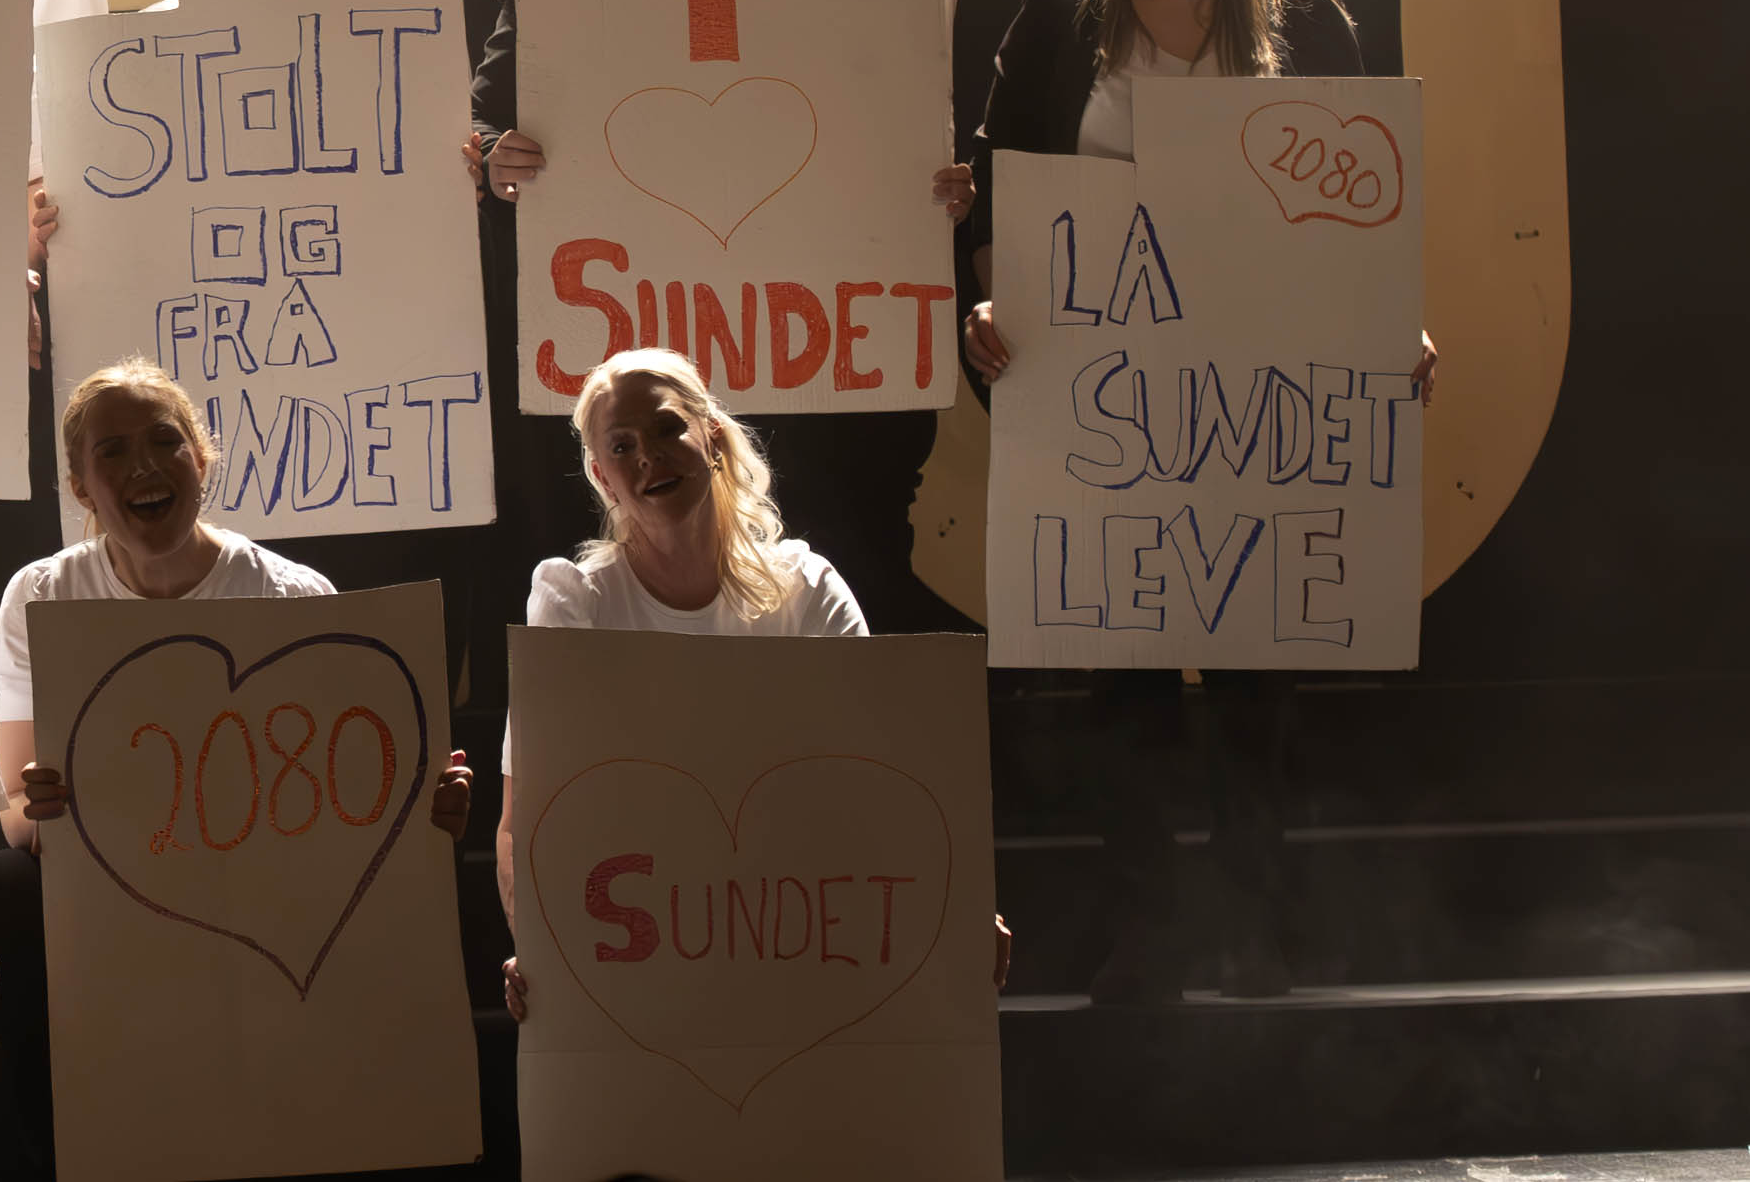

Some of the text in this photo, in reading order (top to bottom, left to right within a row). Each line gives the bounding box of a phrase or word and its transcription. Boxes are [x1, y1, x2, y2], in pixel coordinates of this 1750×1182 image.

[82, 7, 443, 199] STOLT
[1269, 125, 1382, 210] 2080
[190, 204, 342, 286] OG
[1049, 202, 1184, 327] LA
[155, 277, 338, 381] FRA
[536, 237, 955, 398] SUNDET
[1065, 350, 1420, 491] SUNDET
[1033, 505, 1353, 648] LEVE
[130, 701, 397, 855] 2080
[584, 852, 917, 968] SUNDET
